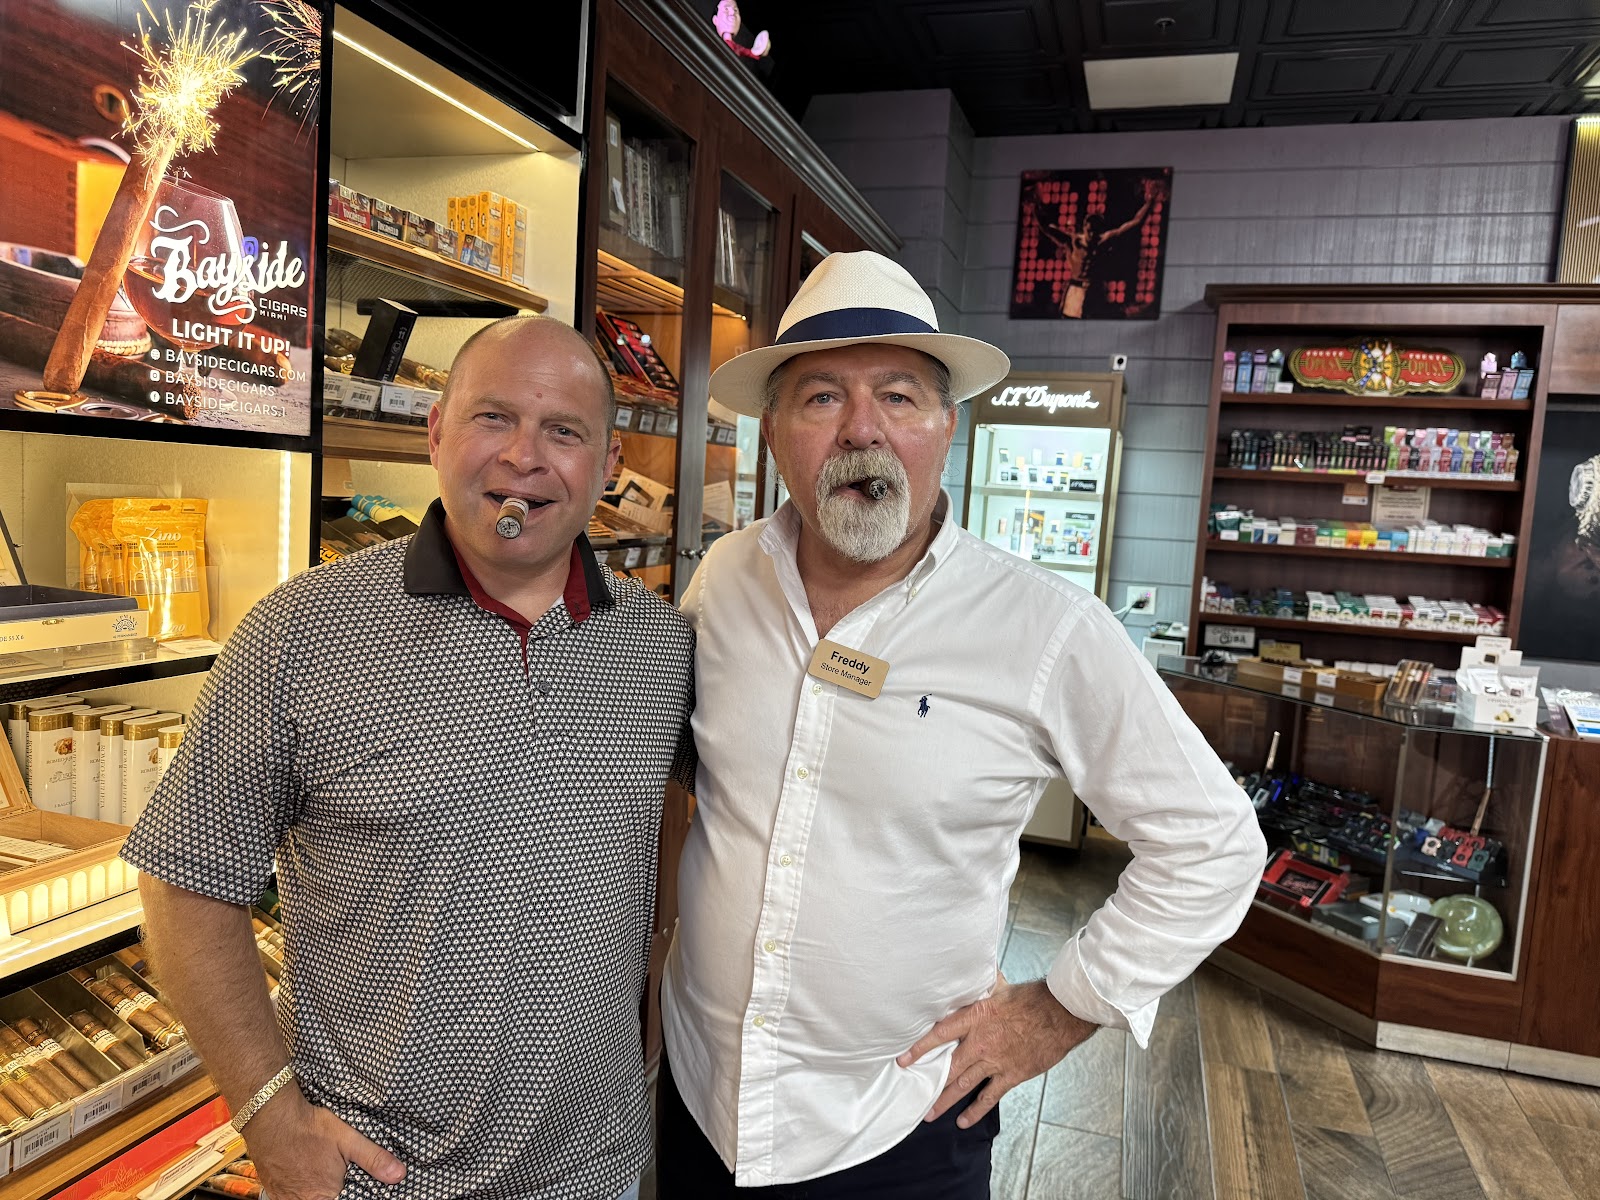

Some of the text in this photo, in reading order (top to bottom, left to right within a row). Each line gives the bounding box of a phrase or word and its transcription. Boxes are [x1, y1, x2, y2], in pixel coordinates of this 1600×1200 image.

[259, 297, 308, 318] CIGARS
[259, 310, 287, 321] MIAMI
[172, 318, 291, 357] LIGHT IT UP!
[166, 349, 306, 382] BAYSIDECIGARS.COM
[165, 371, 276, 397] BAYSIDECIGARS
[1024, 385, 1100, 414] Dupont
[820, 662, 872, 687] Store Manager
[830, 650, 871, 675] Freddy
